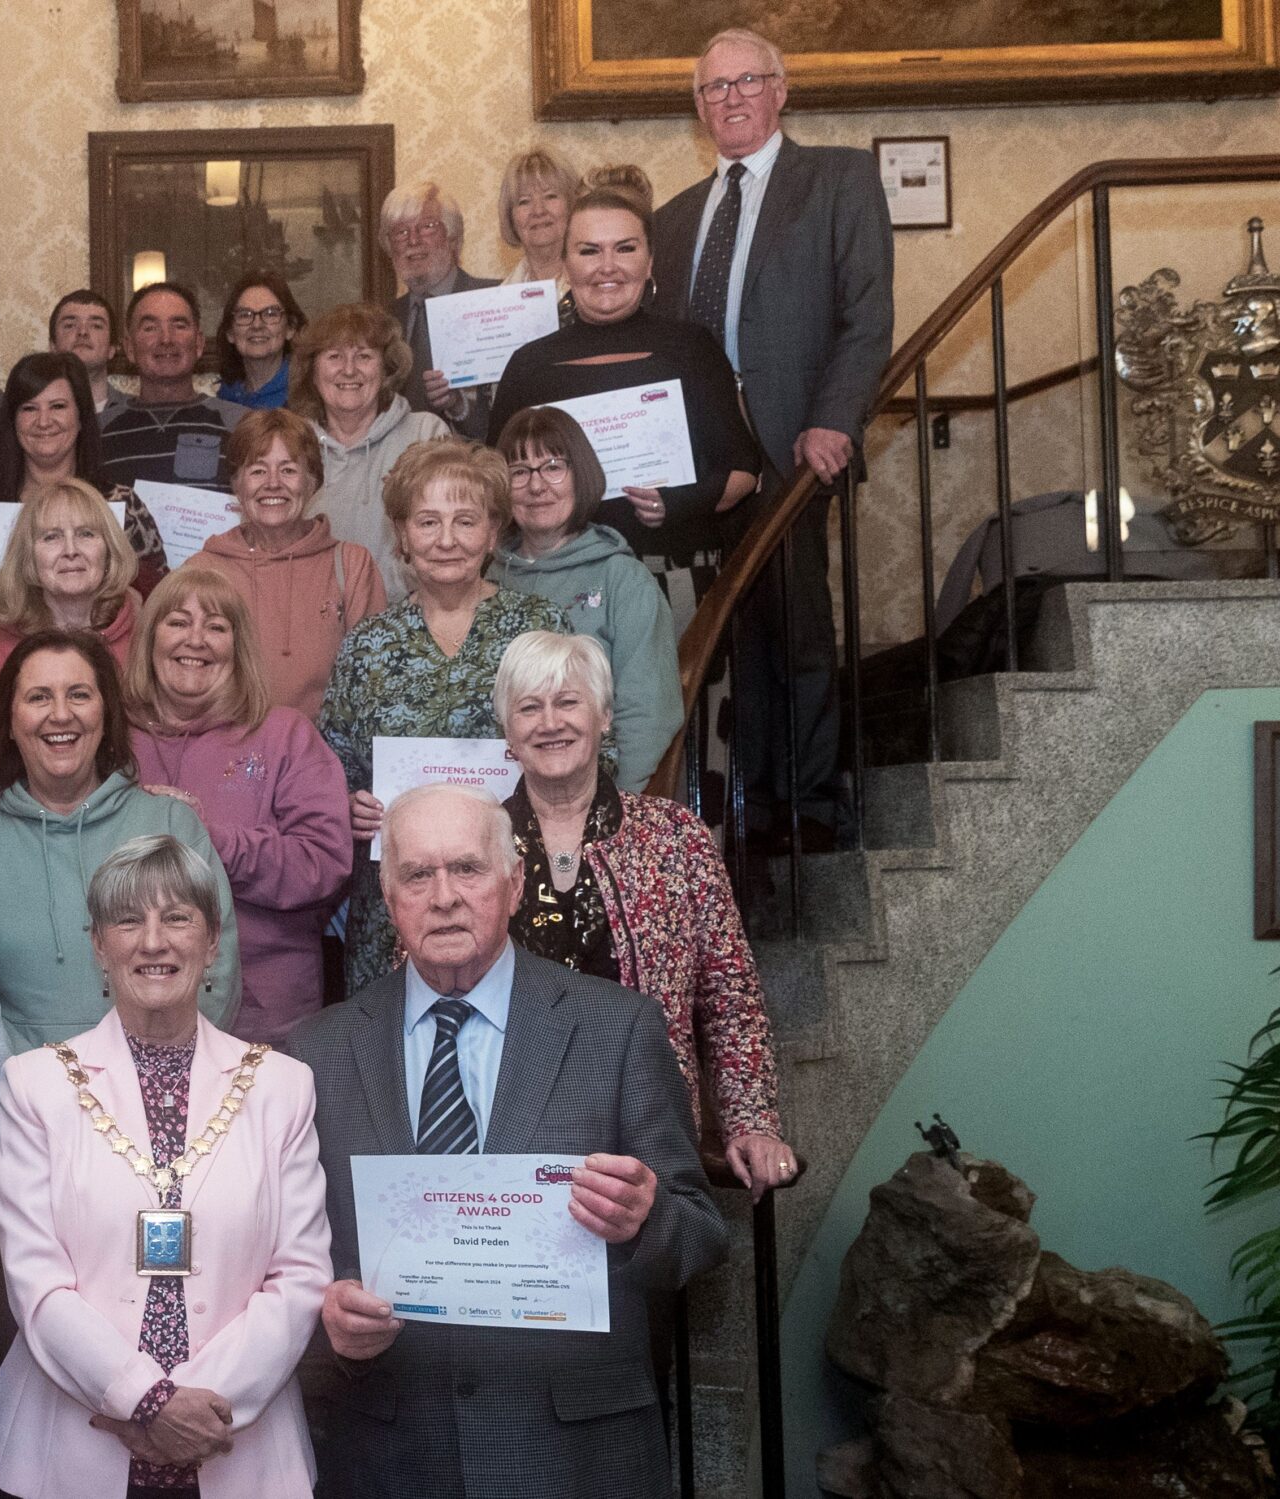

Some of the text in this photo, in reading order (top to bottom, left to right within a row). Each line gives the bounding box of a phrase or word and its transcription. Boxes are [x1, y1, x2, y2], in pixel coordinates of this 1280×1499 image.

[620, 410, 647, 420] GOOD
[594, 422, 628, 433] AWARD
[423, 766, 466, 774] CITIZENS
[478, 768, 508, 776] GOOD
[446, 777, 485, 785] AWARD
[423, 1193, 543, 1203] CITIZENS 4 GOOD
[457, 1207, 511, 1216] AWARD
[454, 1238, 509, 1246] David Peden
[469, 1307, 488, 1315] Sefton
